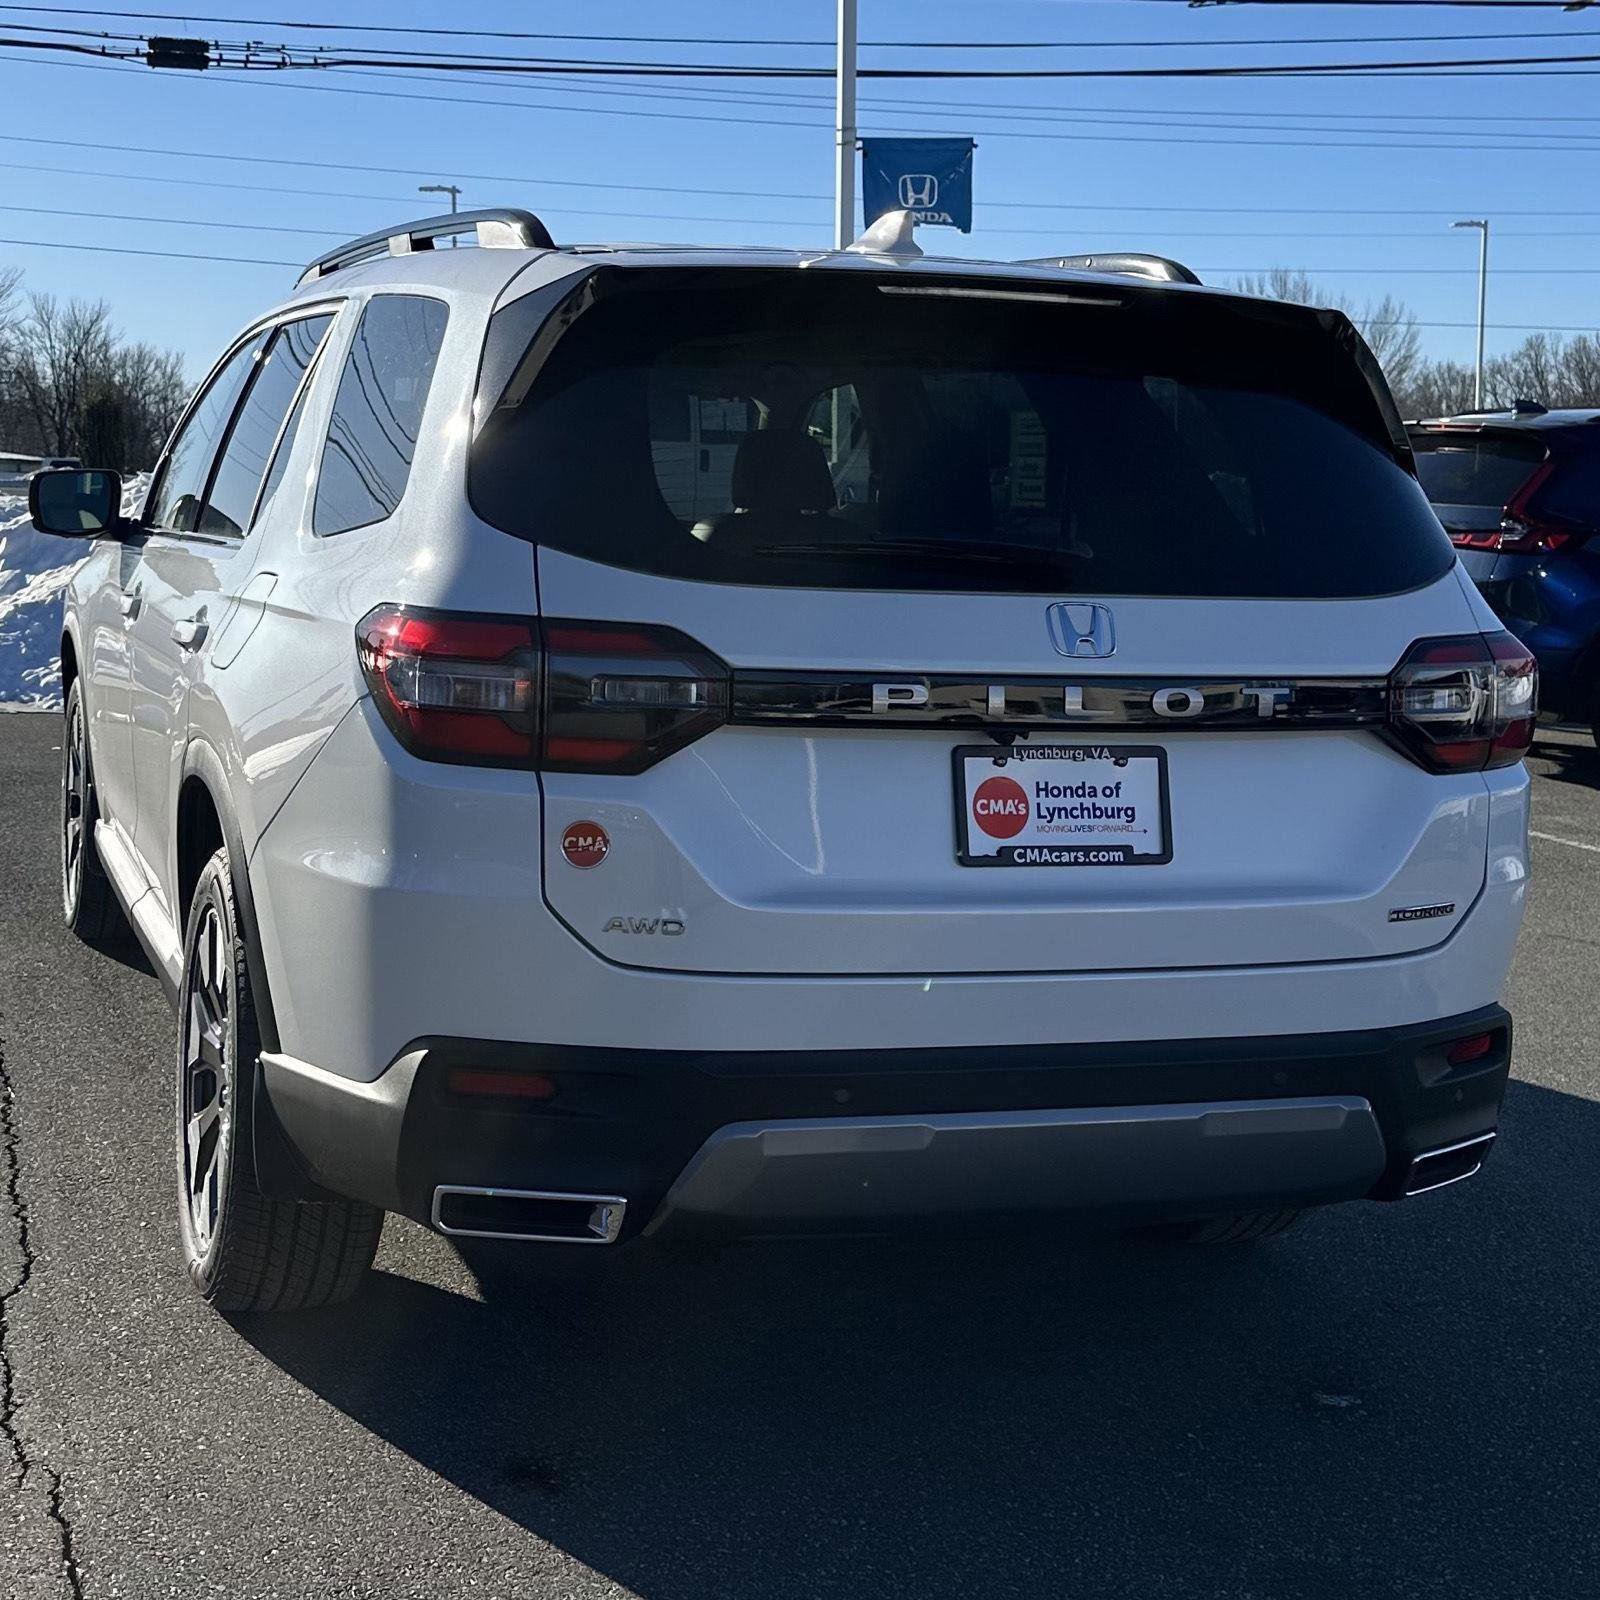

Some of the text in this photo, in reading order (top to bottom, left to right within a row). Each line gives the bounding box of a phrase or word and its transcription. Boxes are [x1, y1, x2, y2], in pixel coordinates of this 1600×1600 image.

[871, 682, 1291, 718] PILOT
[1091, 747, 1111, 759] VA
[1035, 781, 1122, 799] Honda of
[976, 799, 1027, 816] CMA's
[1036, 802, 1136, 823] Lynchburg
[564, 836, 607, 852] CMA
[1013, 848, 1124, 863] CMAcars.com
[602, 916, 686, 936] AWD
